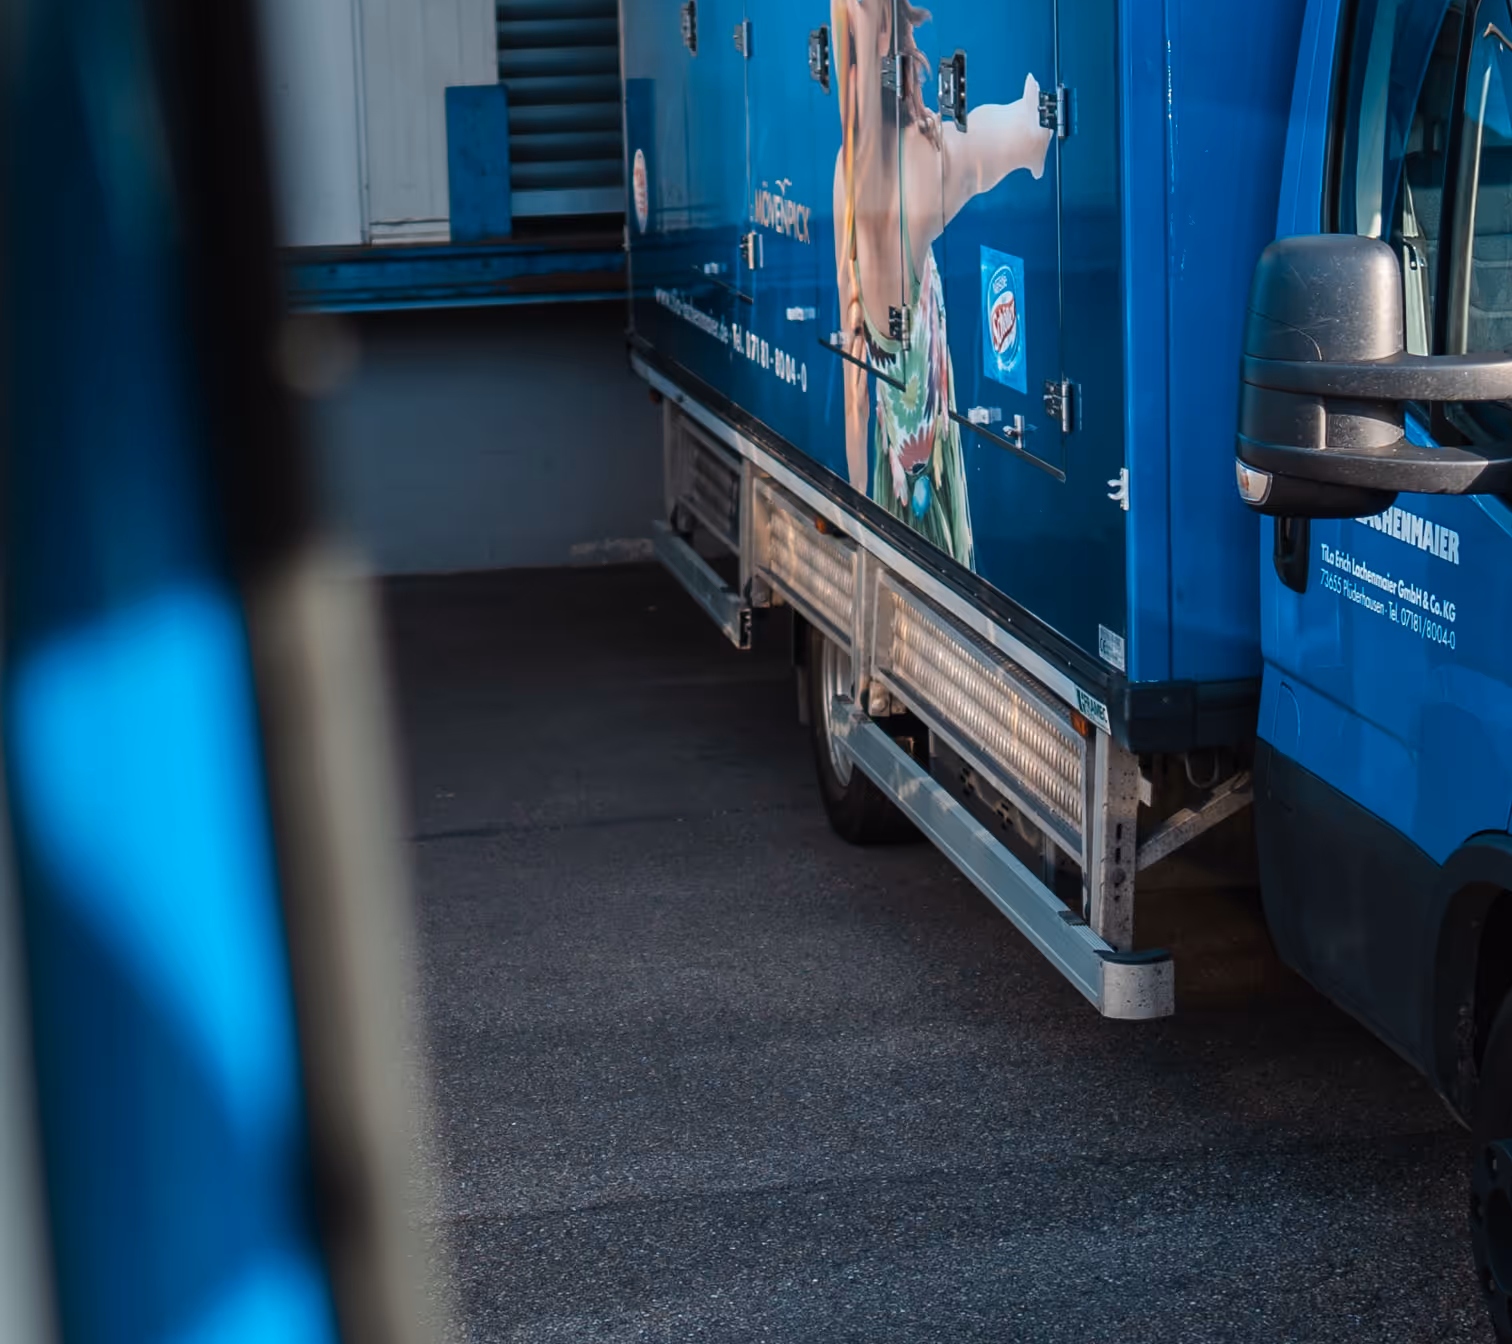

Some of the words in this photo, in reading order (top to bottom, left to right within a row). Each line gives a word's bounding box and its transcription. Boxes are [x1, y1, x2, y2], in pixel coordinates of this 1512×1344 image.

[1355, 506, 1459, 565] CHENMAIER
[1320, 568, 1342, 594] 73655
[1343, 579, 1385, 616] Plüderhausen
[1400, 608, 1456, 649] 07181/8004-0
[1335, 550, 1351, 573] Erich
[1352, 558, 1397, 595] Lachenmaier
[1398, 580, 1422, 607] GmbH
[1422, 591, 1429, 610] &
[1430, 594, 1442, 617] Co.
[1443, 600, 1456, 622] KG
